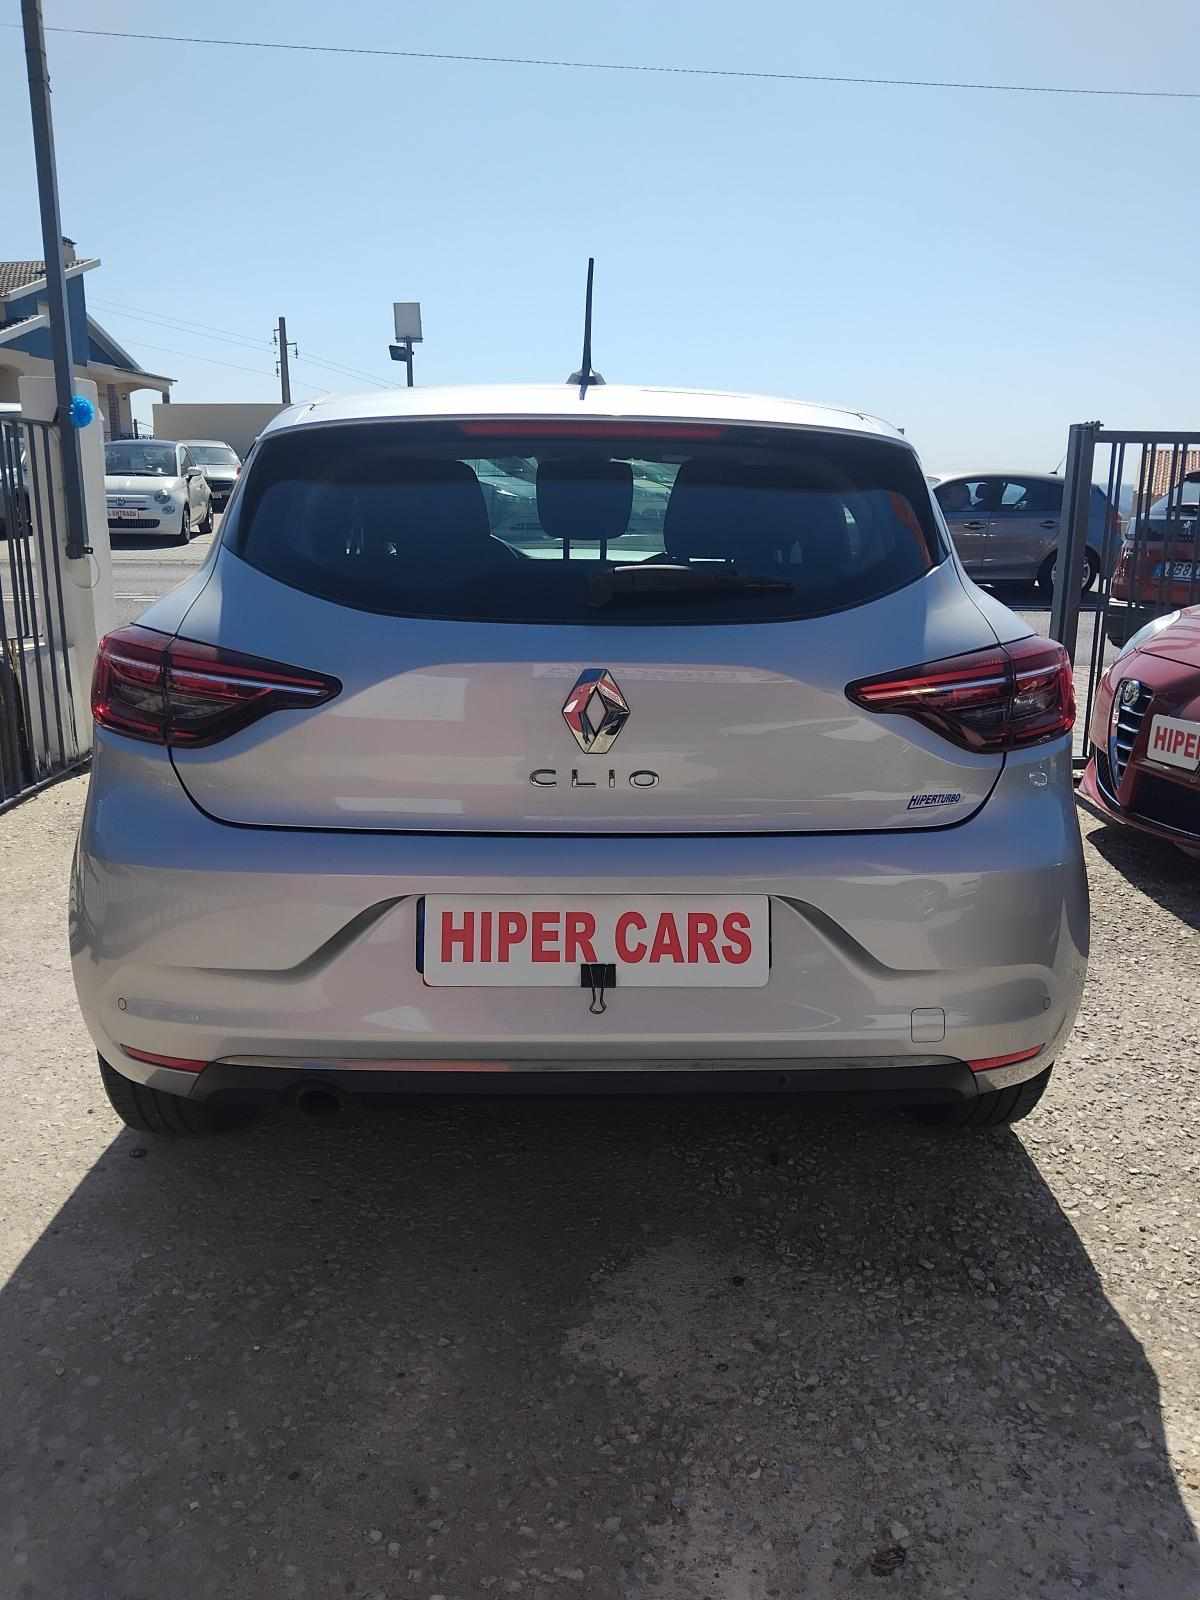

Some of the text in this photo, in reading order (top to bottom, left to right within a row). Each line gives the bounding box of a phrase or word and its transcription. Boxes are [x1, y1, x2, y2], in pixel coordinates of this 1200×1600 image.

[529, 768, 660, 789] CLIO
[907, 793, 961, 809] HIPERTURBO
[440, 911, 752, 964] HIPER CARS
